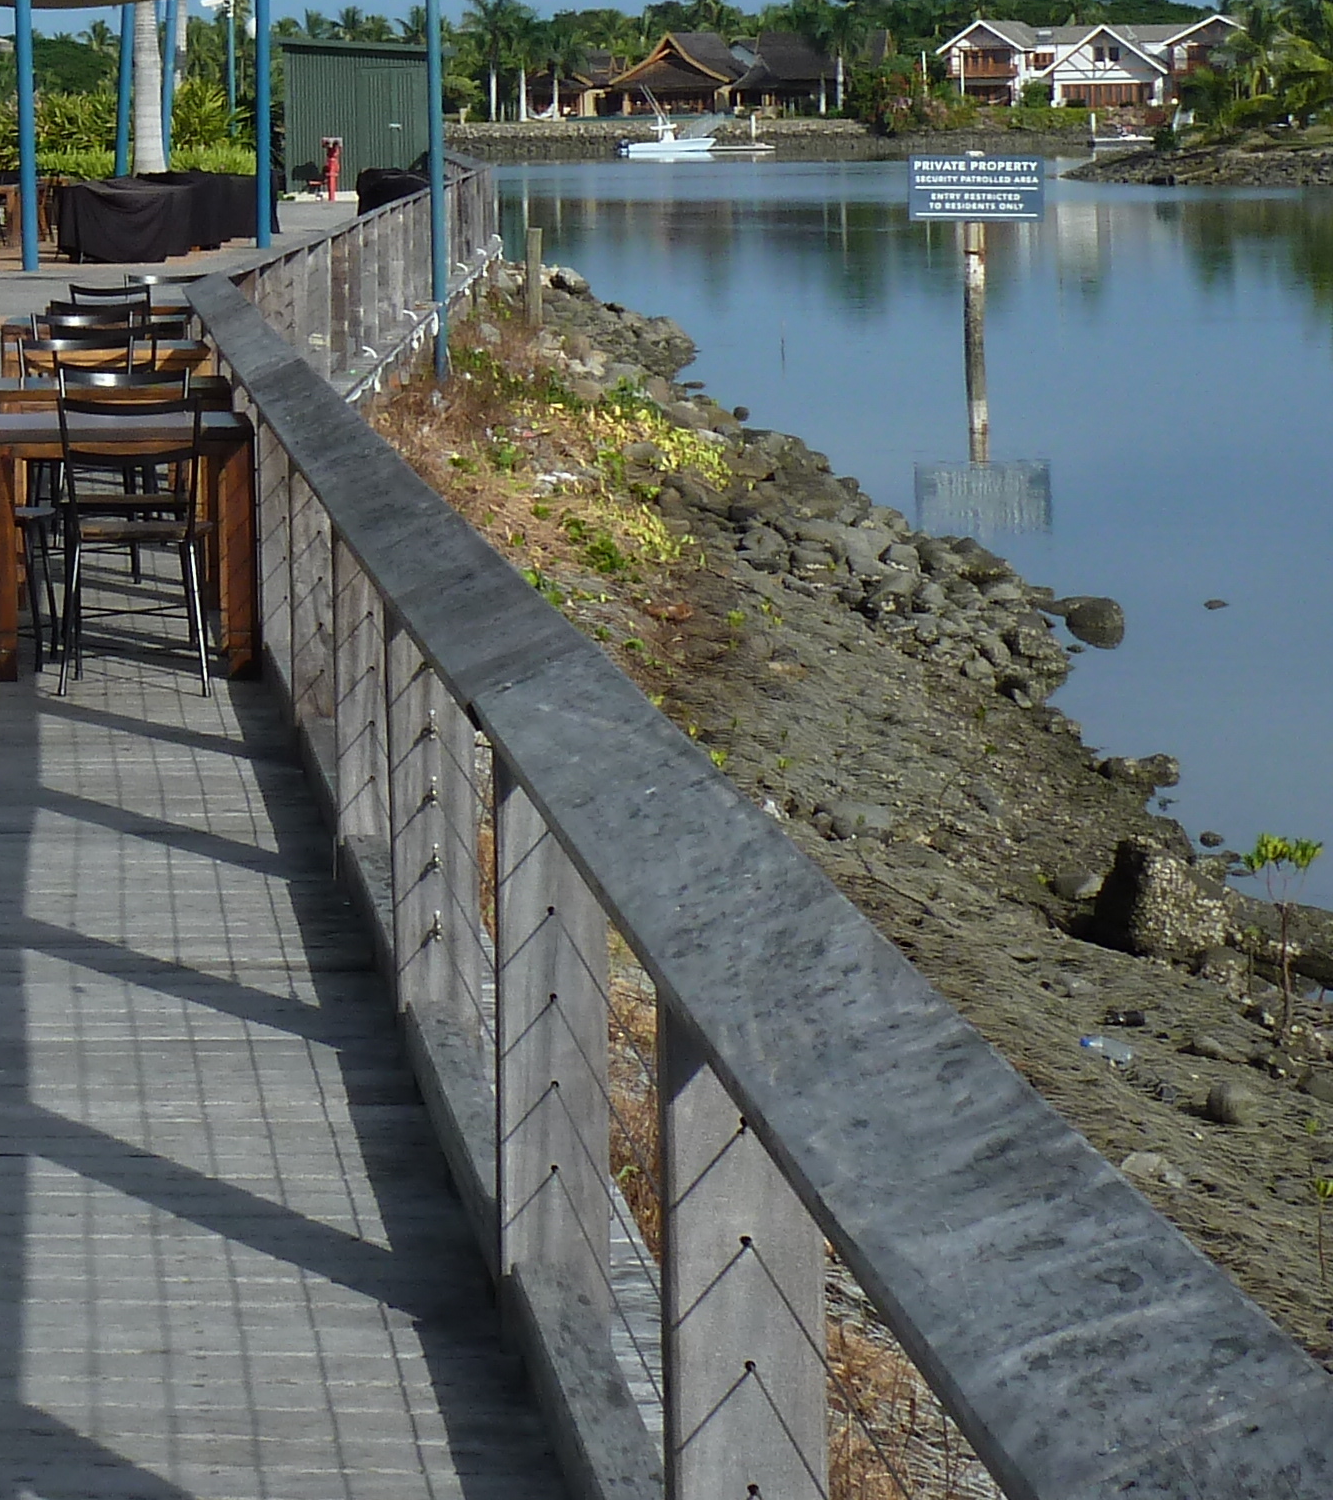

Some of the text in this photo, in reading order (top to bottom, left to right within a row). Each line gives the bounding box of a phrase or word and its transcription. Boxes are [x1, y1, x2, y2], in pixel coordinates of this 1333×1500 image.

[913, 161, 1038, 172] PRIVATE PROPERTY
[915, 175, 1039, 184] SECURITY PATROLLED AREA
[963, 193, 1021, 201] RESTRICTED
[928, 202, 1025, 211] TO RESIDENTS ONLY
